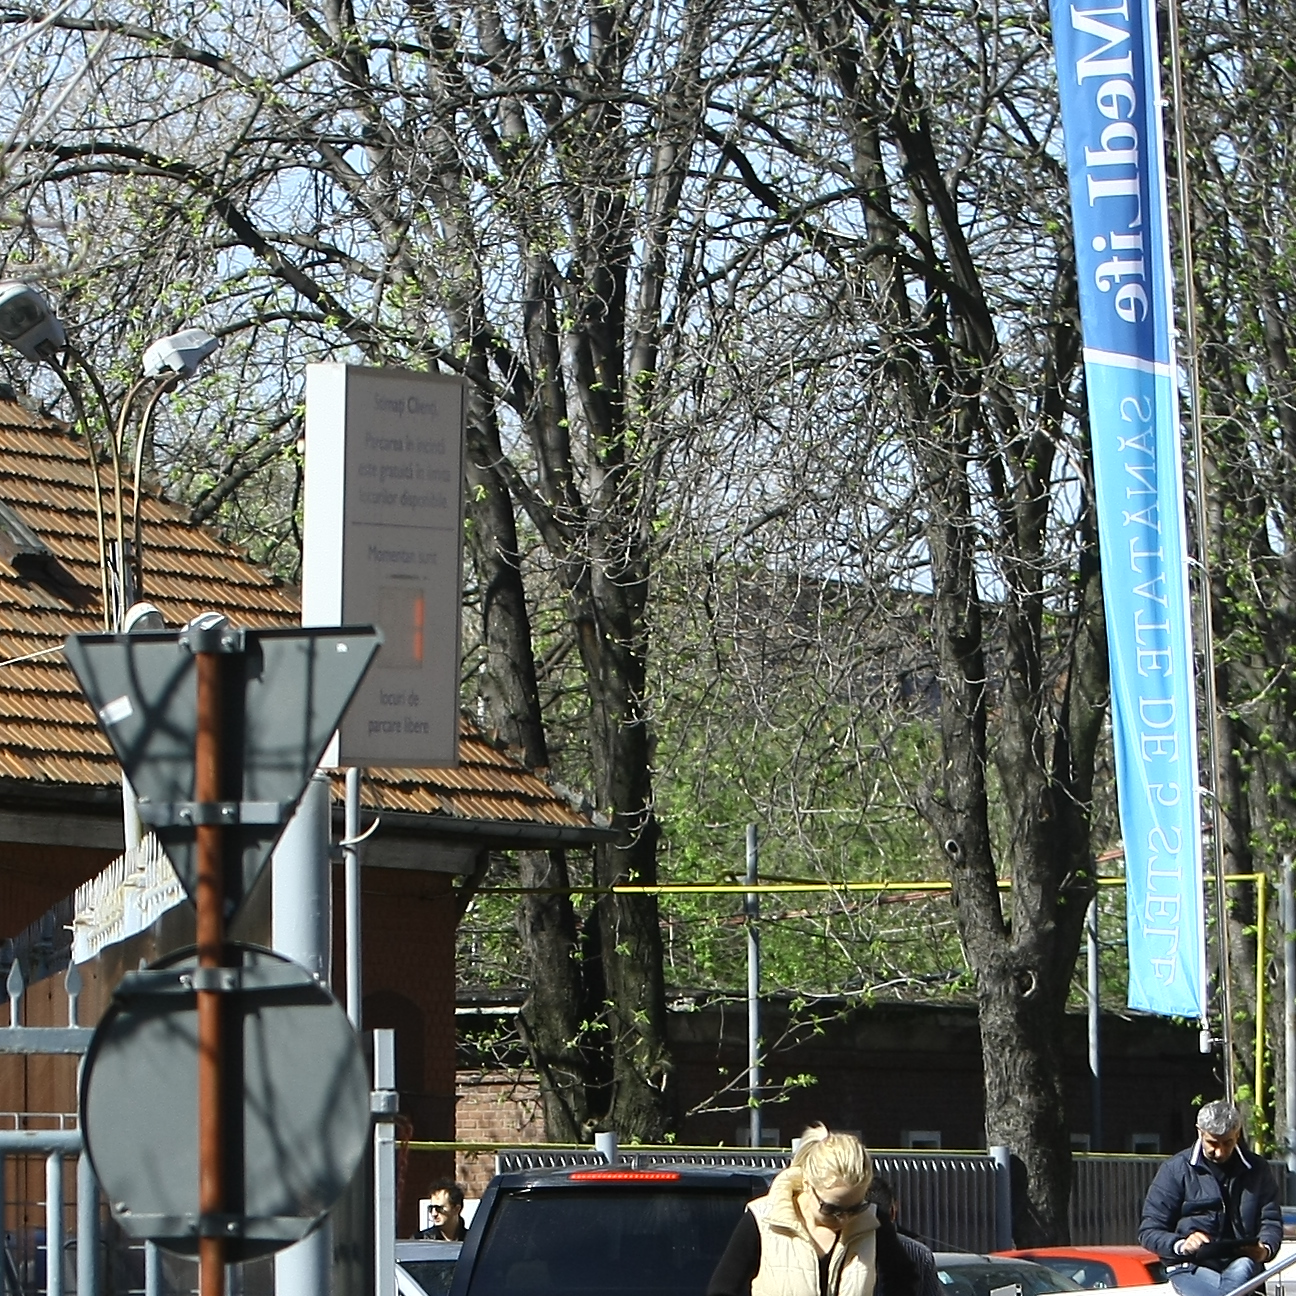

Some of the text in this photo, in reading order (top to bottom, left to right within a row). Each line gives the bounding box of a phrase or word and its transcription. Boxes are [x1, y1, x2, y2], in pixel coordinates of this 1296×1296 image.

[379, 687, 420, 707] locuri de
[368, 716, 429, 737] parcare libere
